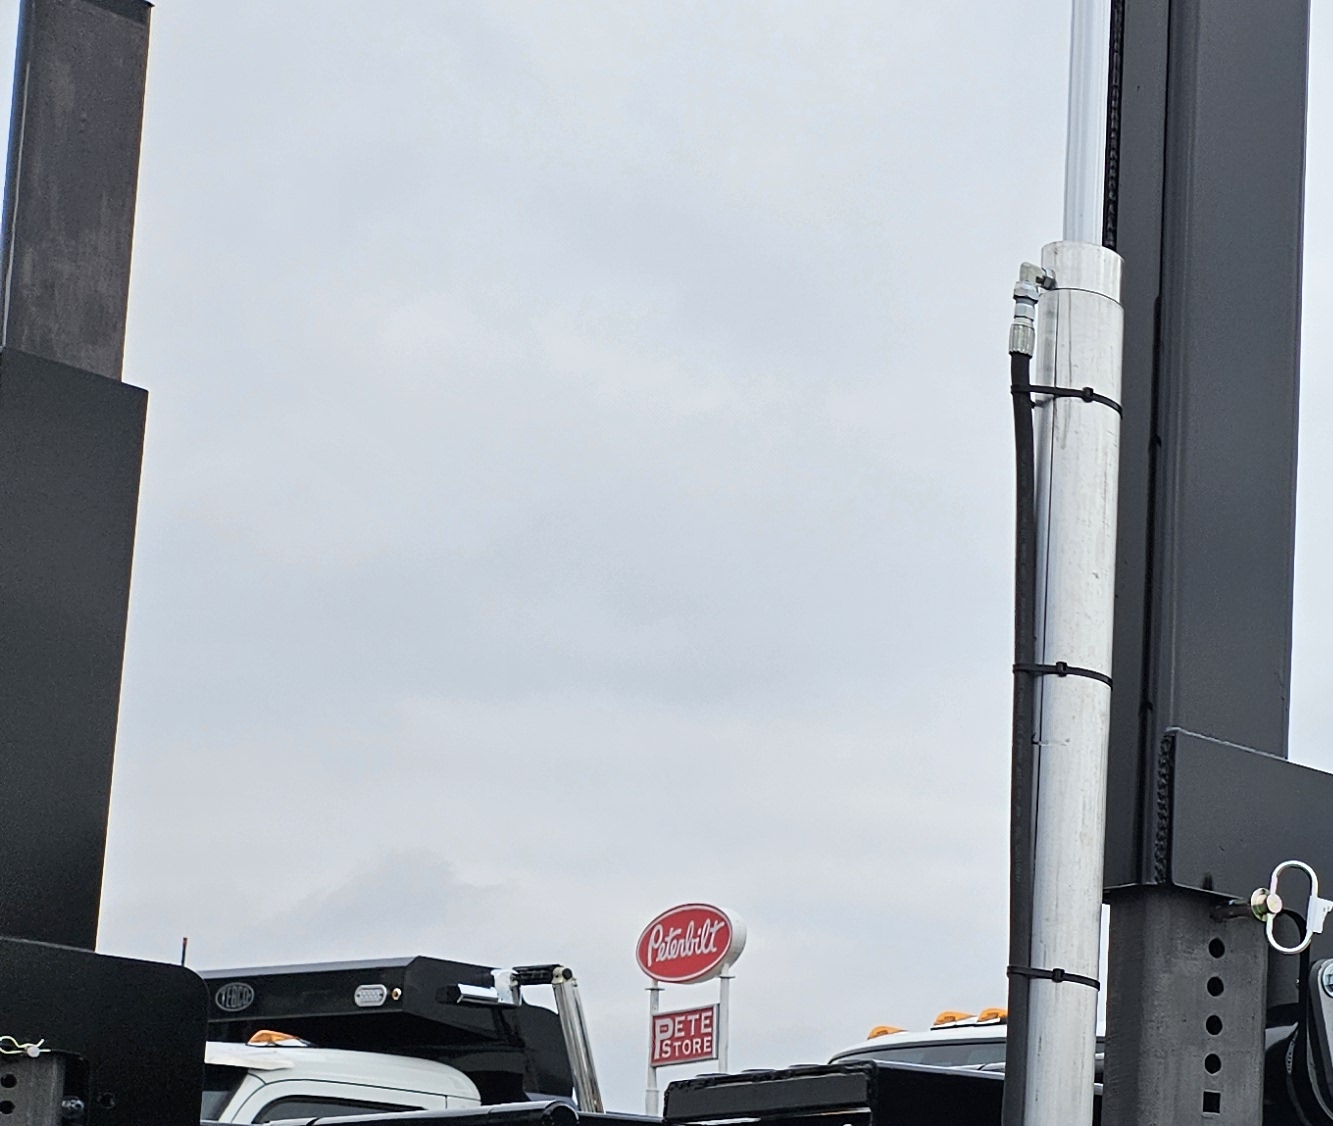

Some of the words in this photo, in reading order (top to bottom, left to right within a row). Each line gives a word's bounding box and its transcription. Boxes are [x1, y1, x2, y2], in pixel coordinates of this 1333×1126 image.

[647, 917, 726, 968] Peterbilt
[654, 1011, 713, 1060] PETE
[661, 1036, 712, 1058] STORE
